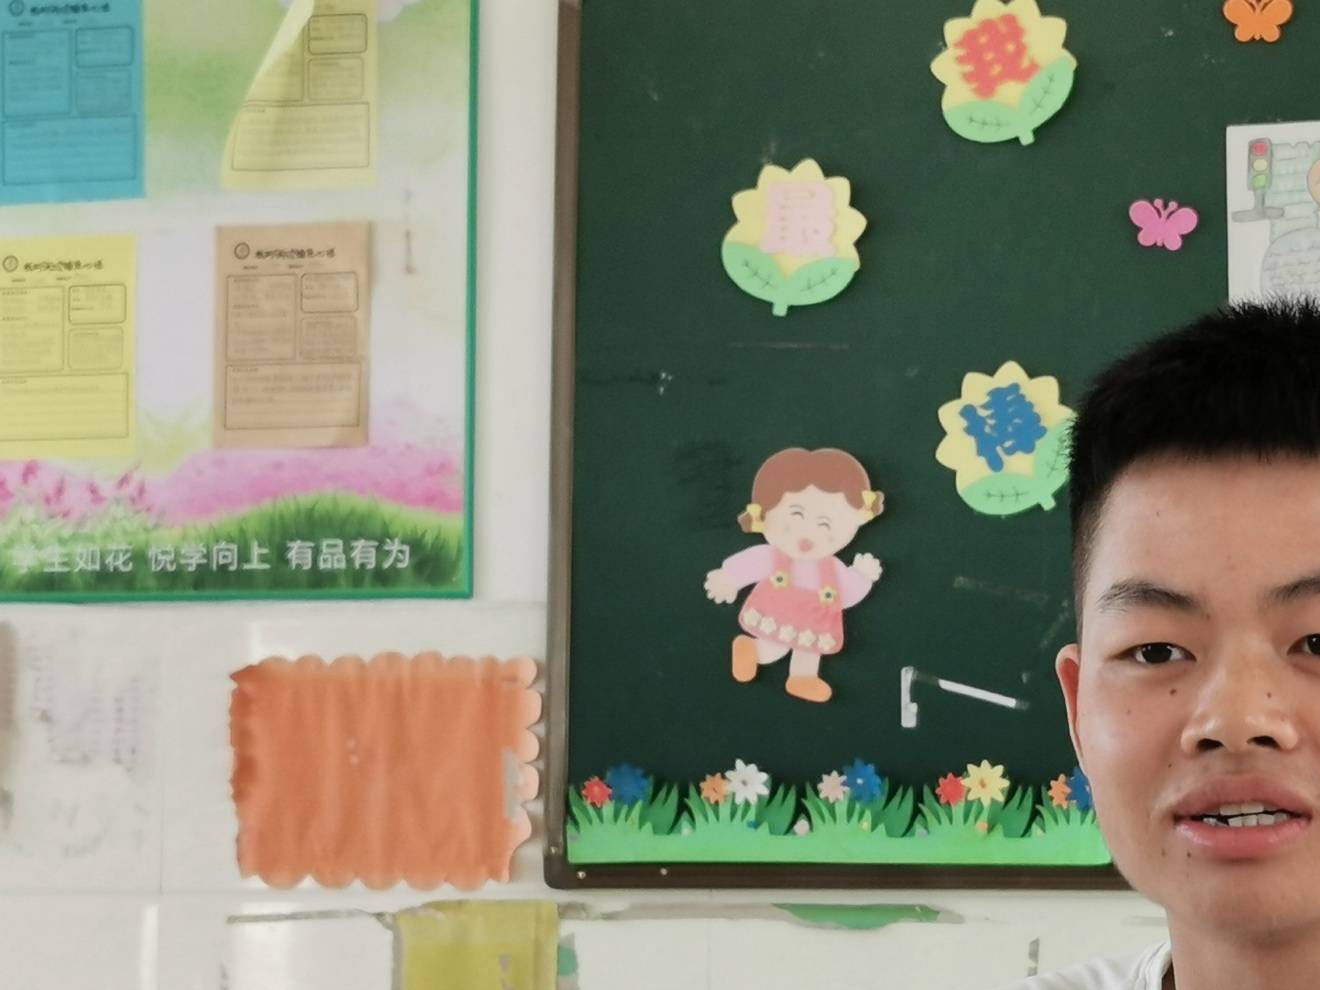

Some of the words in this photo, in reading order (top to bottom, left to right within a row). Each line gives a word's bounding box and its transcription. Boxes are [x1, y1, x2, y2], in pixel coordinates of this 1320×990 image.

[148, 541, 271, 572] 悦学向上
[285, 537, 411, 570] 有品有为
